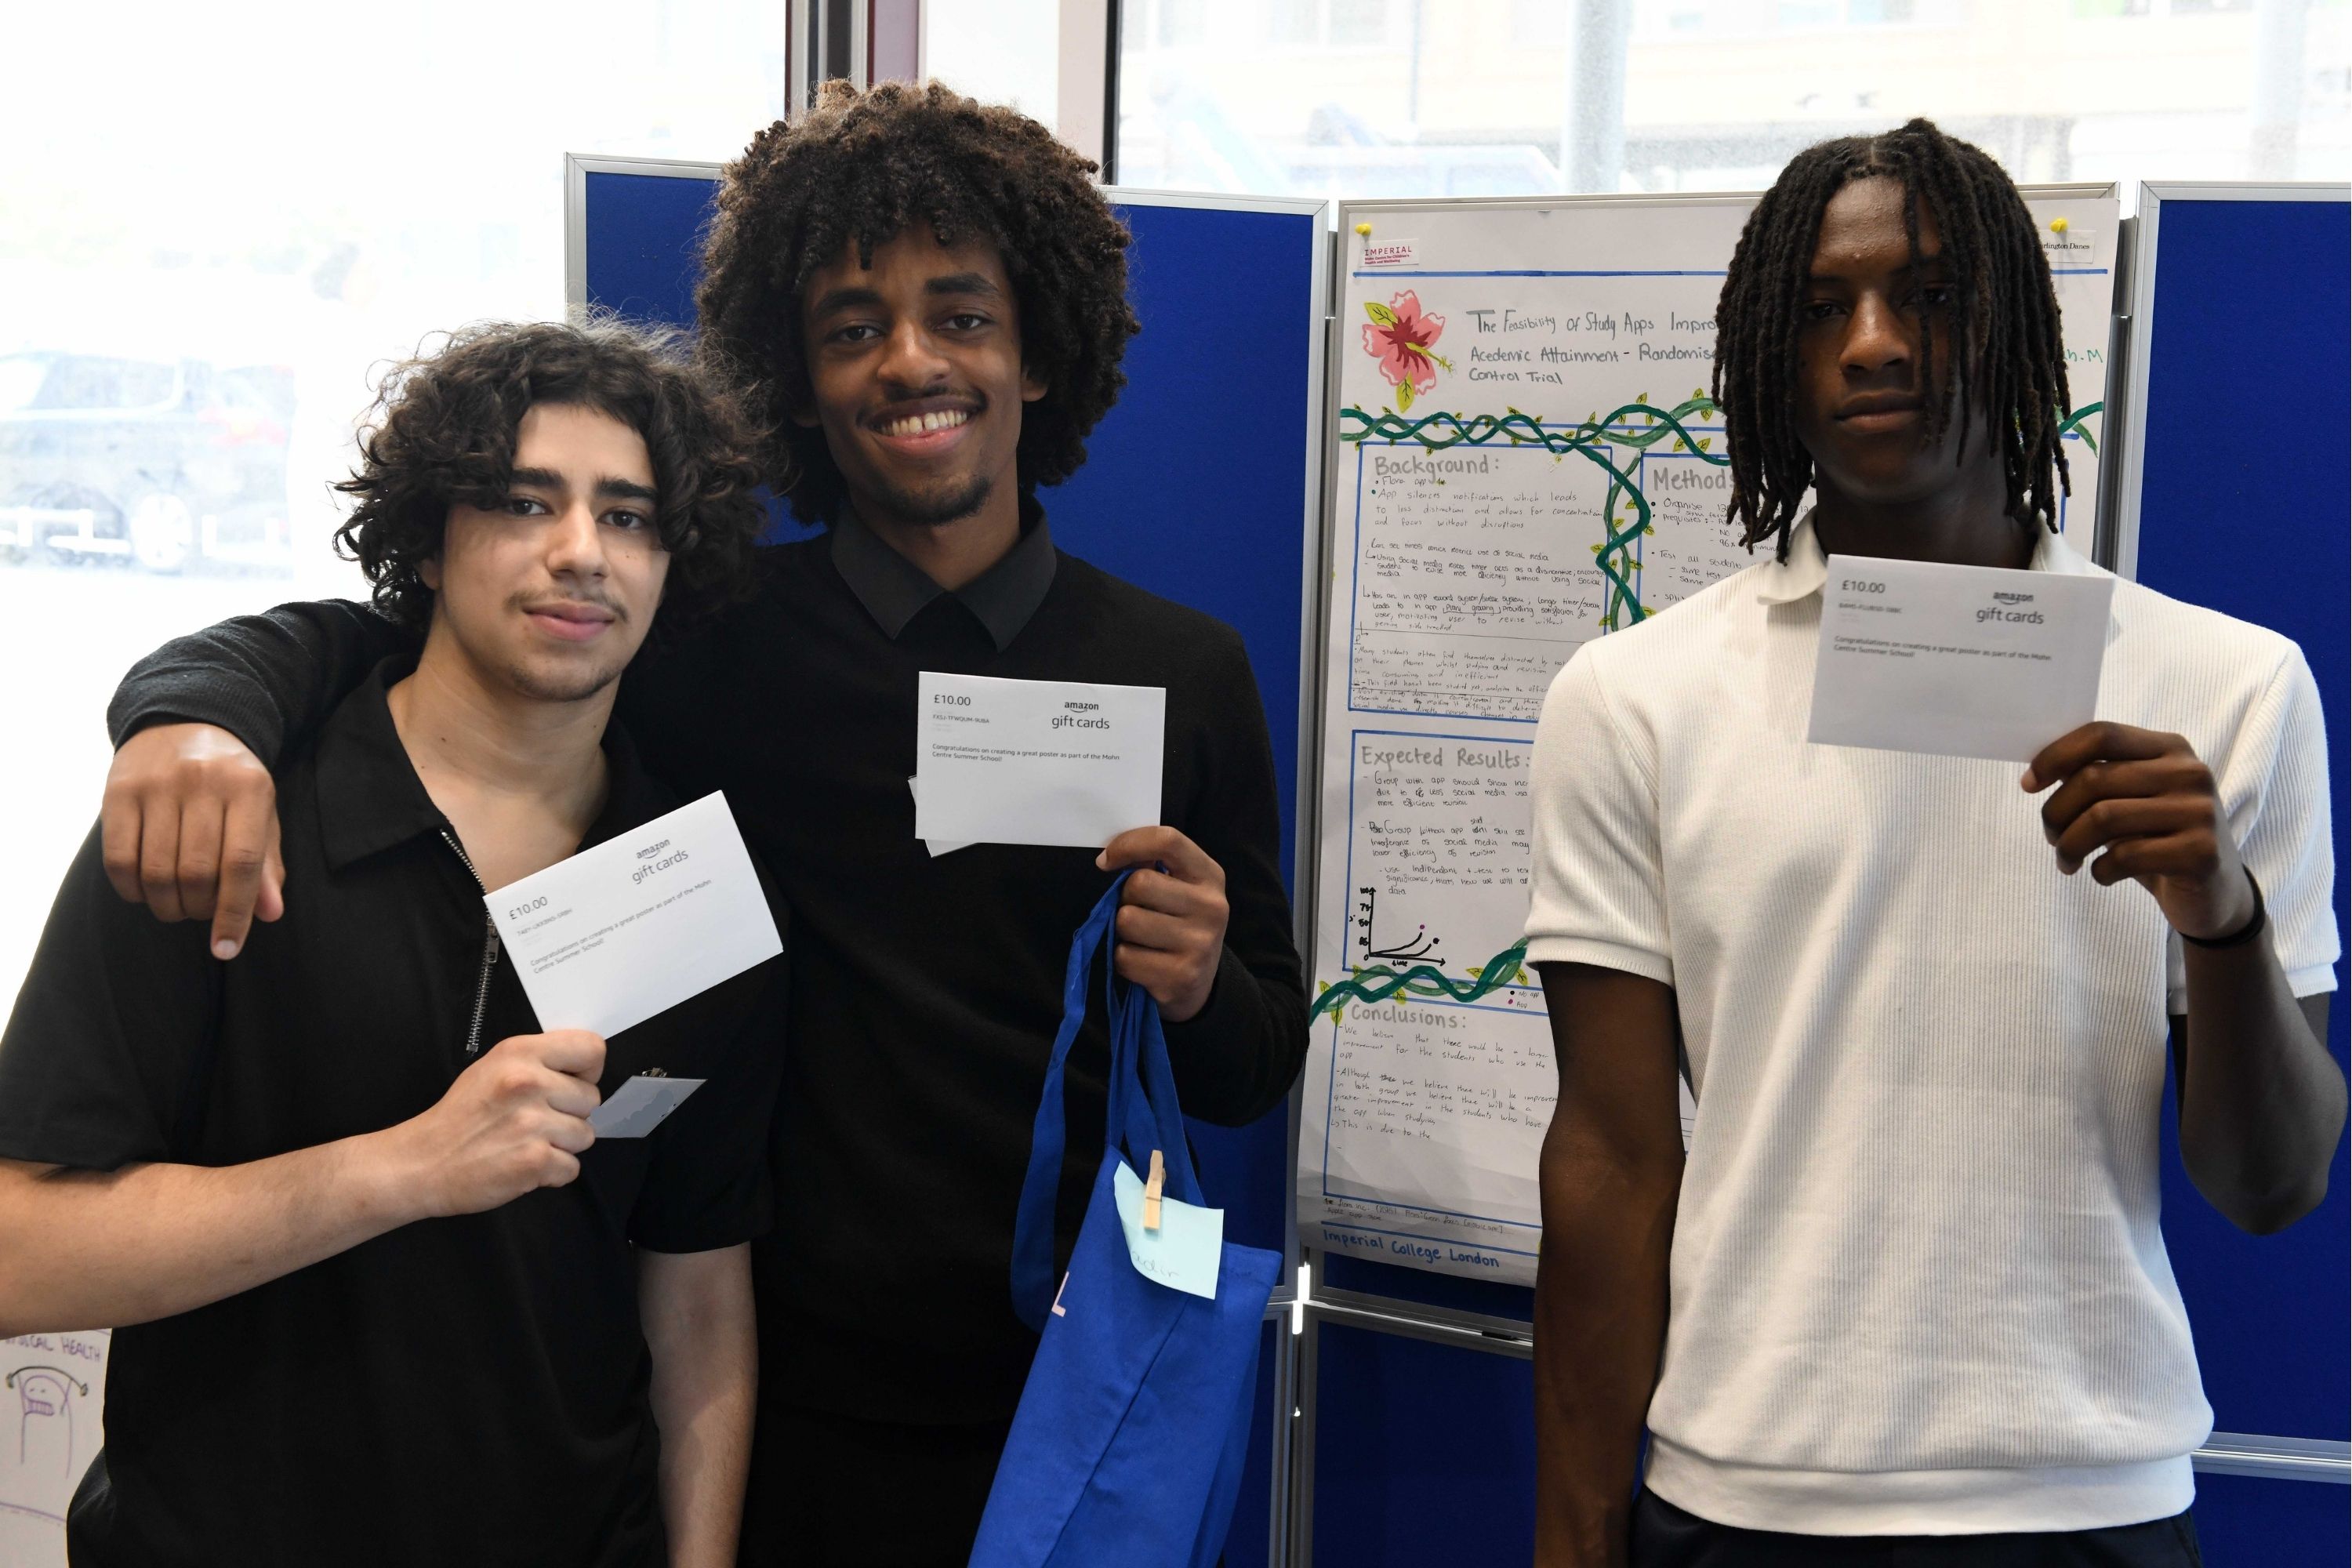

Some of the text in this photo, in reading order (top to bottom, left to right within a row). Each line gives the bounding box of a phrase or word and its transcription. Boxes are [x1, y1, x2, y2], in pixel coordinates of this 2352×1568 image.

[1364, 245, 1412, 256] IMPERIAL
[1466, 309, 1496, 333] The
[1504, 309, 1556, 334] Feasibility
[1585, 311, 1617, 340] Study
[1624, 312, 1655, 336] Apps
[1541, 346, 1619, 364] Attainment
[1468, 367, 1563, 386] Control Trial
[1414, 478, 1427, 487] app
[1378, 488, 1397, 500] App
[1513, 492, 1539, 503] which
[1551, 491, 1577, 502] leads
[1376, 505, 1386, 514] to
[1475, 505, 1490, 515] and
[1530, 506, 1544, 517] for
[1664, 498, 1703, 514] Organise
[1375, 516, 1388, 526] and
[1437, 519, 1468, 528] without
[1842, 580, 1886, 593] £10.00
[1993, 591, 2034, 604] amazon
[1976, 607, 2045, 625] gift cards
[934, 695, 971, 706] £10.00
[1064, 701, 1099, 712] amazon
[1052, 715, 1110, 729] gift cards
[933, 744, 980, 754] Congratulations
[953, 752, 979, 760] Summer
[1362, 746, 1443, 772] Expected
[1374, 771, 1399, 785] Group
[1376, 787, 1391, 797] due
[635, 839, 671, 859] amazon
[1512, 841, 1530, 855] may
[632, 849, 689, 885] gift cards
[509, 896, 548, 921] £10.00
[1323, 1229, 1500, 1268] Imperial College London
